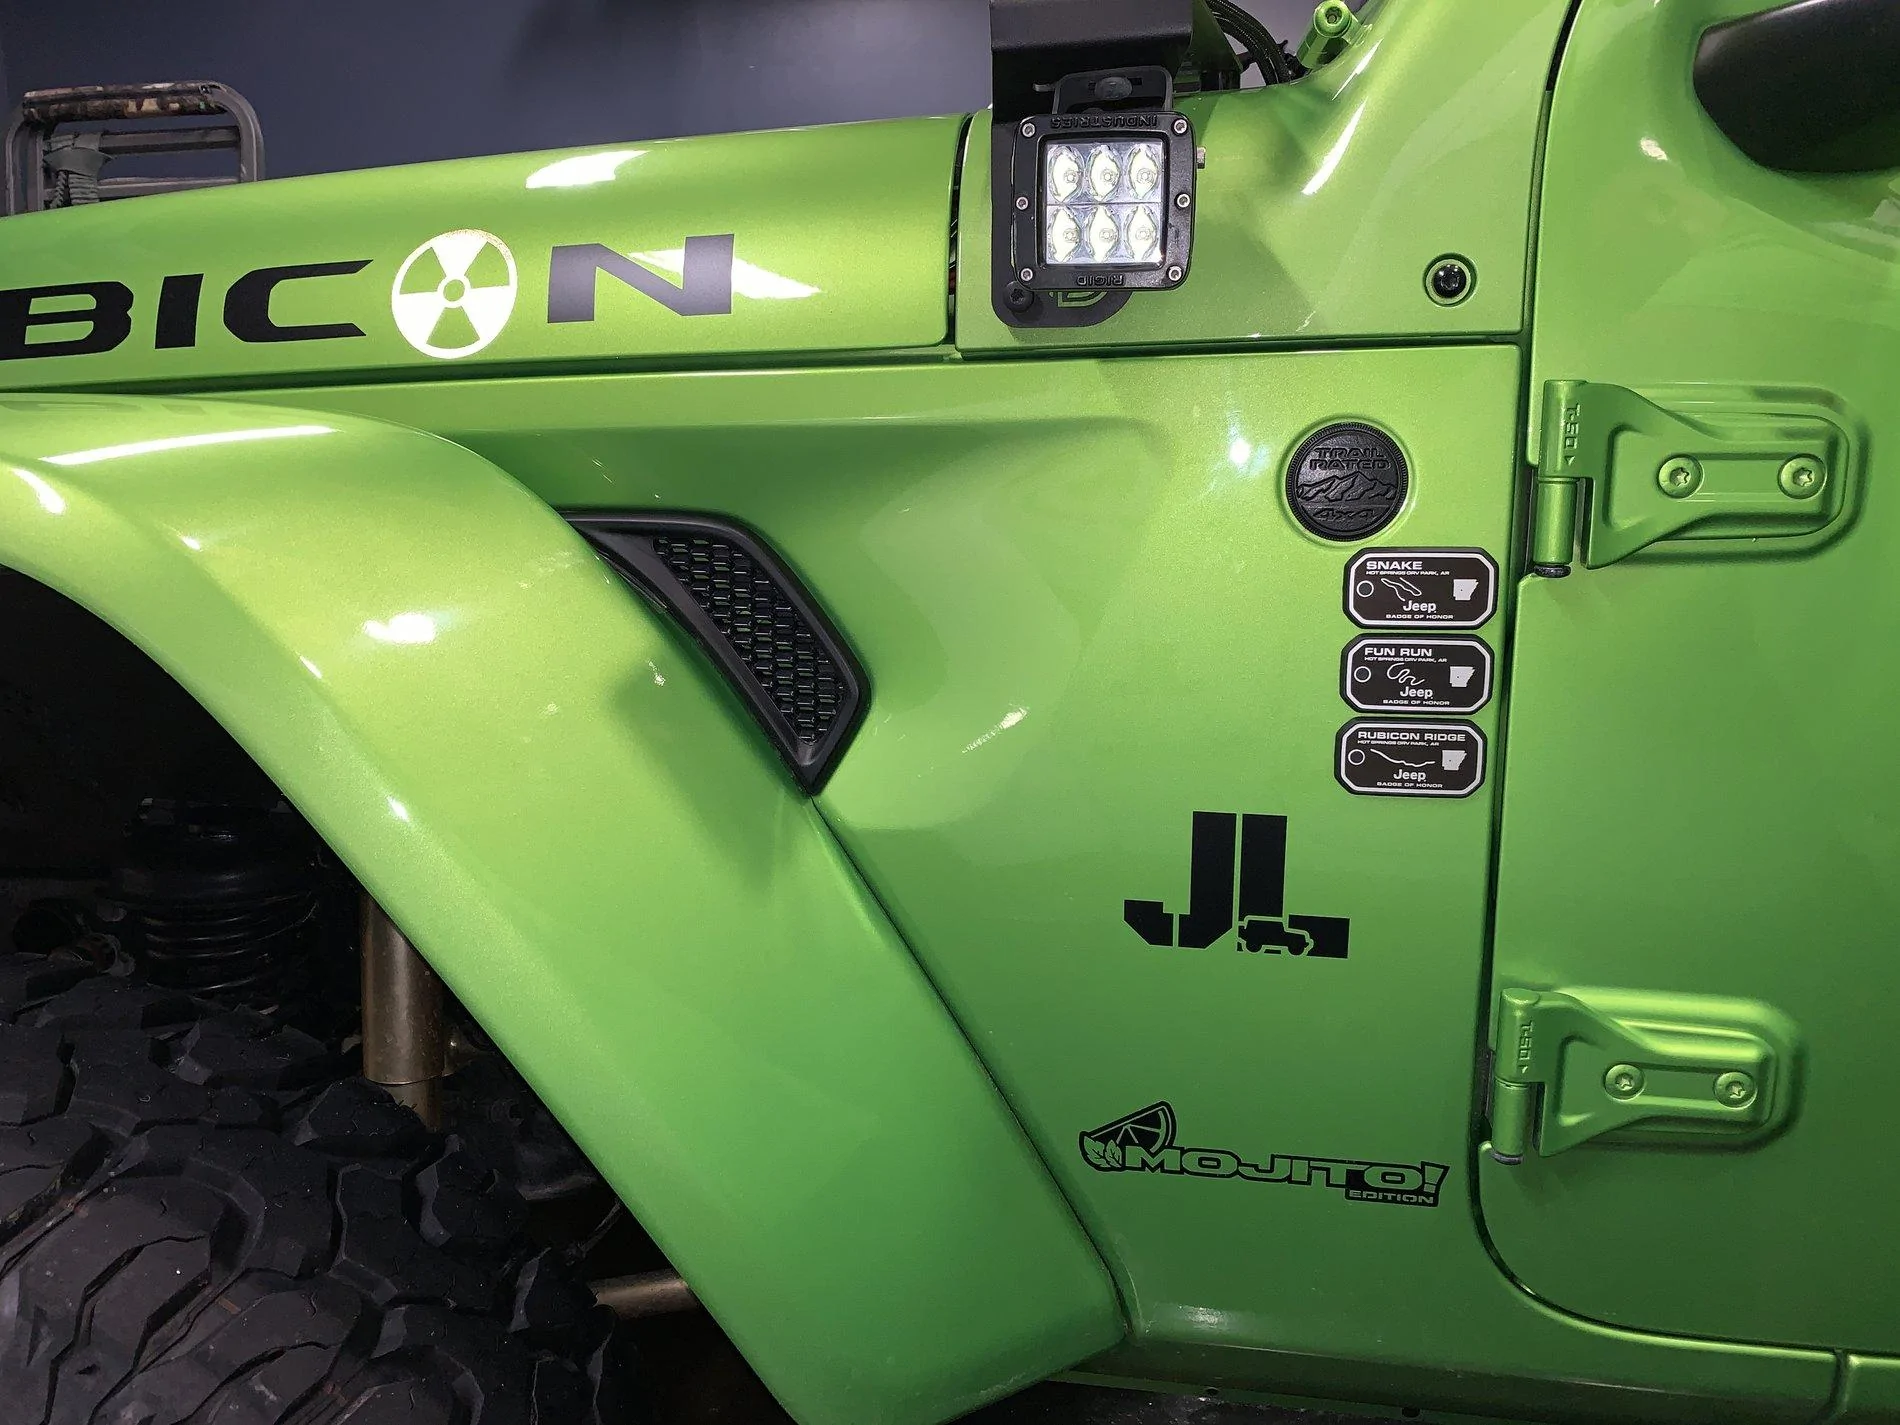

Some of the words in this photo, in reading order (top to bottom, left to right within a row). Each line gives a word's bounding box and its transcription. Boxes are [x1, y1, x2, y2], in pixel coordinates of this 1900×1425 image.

[1051, 113, 1157, 129] INDUSTRIES
[1077, 274, 1125, 286] RIGID
[1315, 447, 1387, 458] TRAIL
[1309, 459, 1390, 470] RATED
[1366, 561, 1423, 570] SNAKE
[1403, 600, 1436, 613] Jeep
[1364, 647, 1395, 656] FUN
[1400, 648, 1432, 657] RUN
[1399, 686, 1433, 699] Jeep
[1358, 731, 1420, 740] RUBICON
[1424, 733, 1466, 741] RIDGE
[1393, 769, 1427, 782] Jeep
[1124, 811, 1350, 959] JL
[1122, 1144, 1450, 1196] MOJITO!
[1348, 1189, 1434, 1204] EDITION
